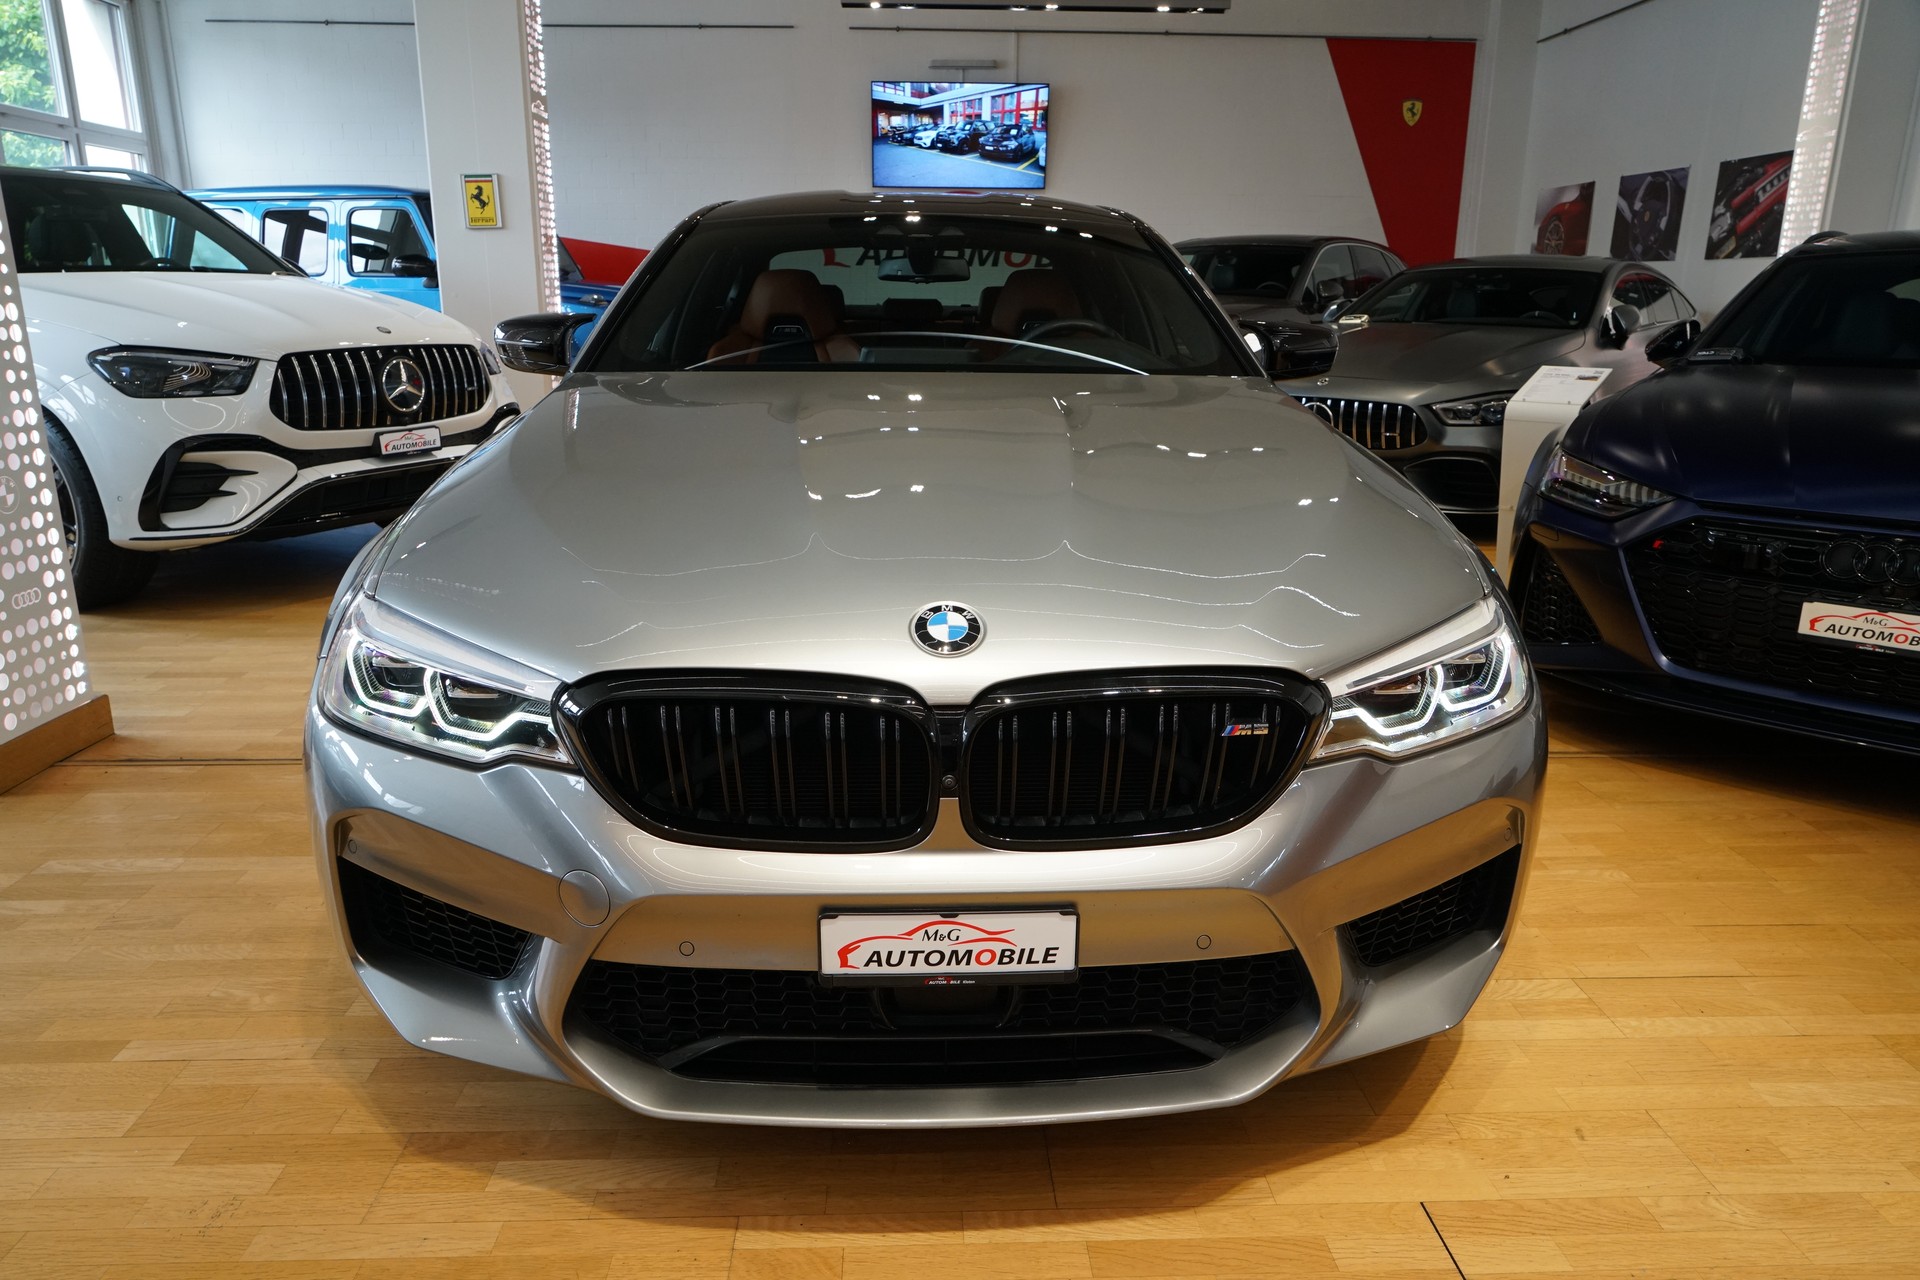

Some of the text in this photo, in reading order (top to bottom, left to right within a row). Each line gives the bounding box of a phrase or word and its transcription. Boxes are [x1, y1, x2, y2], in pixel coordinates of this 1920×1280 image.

[391, 438, 437, 451] AUTOMOBILE
[920, 605, 975, 620] BMW
[1862, 616, 1889, 627] M&G
[922, 928, 961, 942] M&G
[863, 946, 1060, 968] AUTOMOBILE
